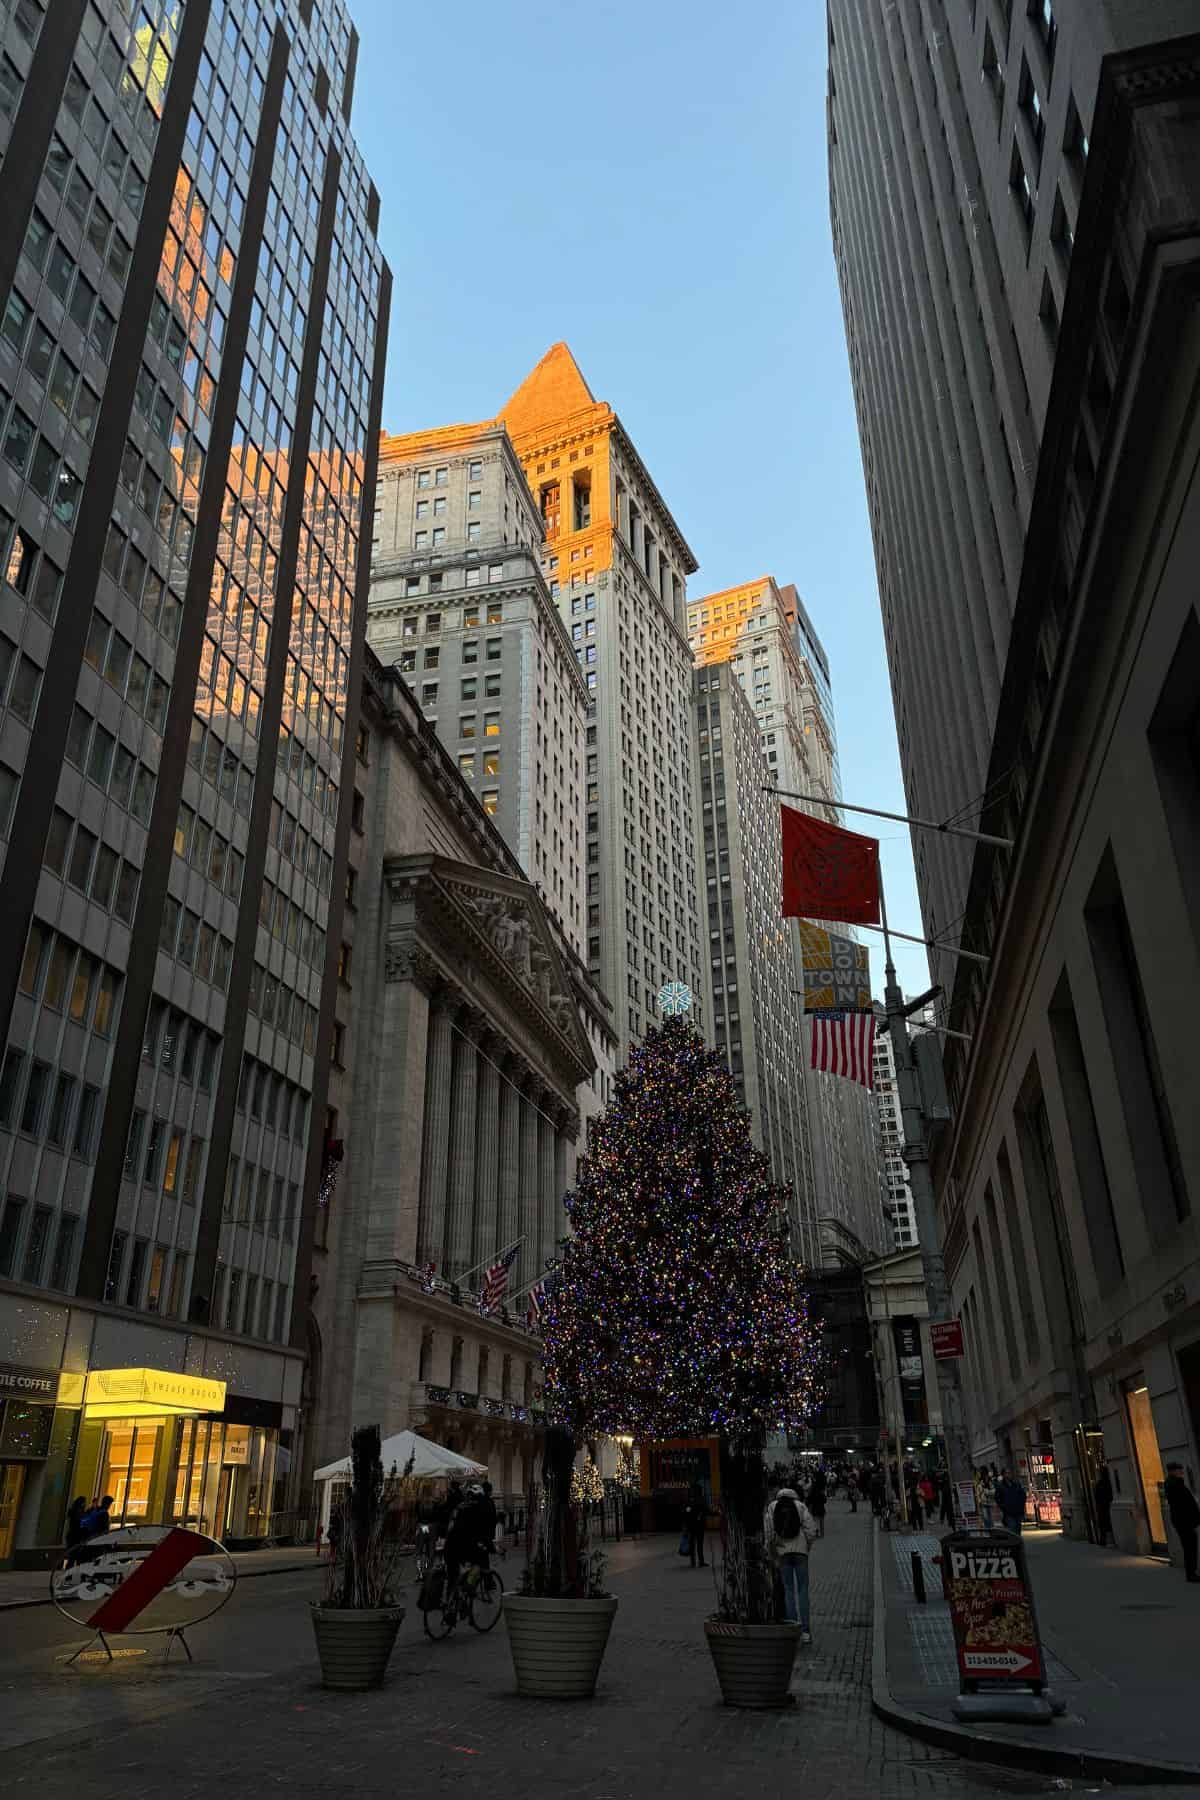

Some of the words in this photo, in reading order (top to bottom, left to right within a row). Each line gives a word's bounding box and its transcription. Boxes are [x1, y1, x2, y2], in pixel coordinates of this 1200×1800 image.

[17, 1376, 51, 1391] COFFEE
[1031, 1455, 1043, 1465] NY
[951, 1551, 1019, 1579] Pizza
